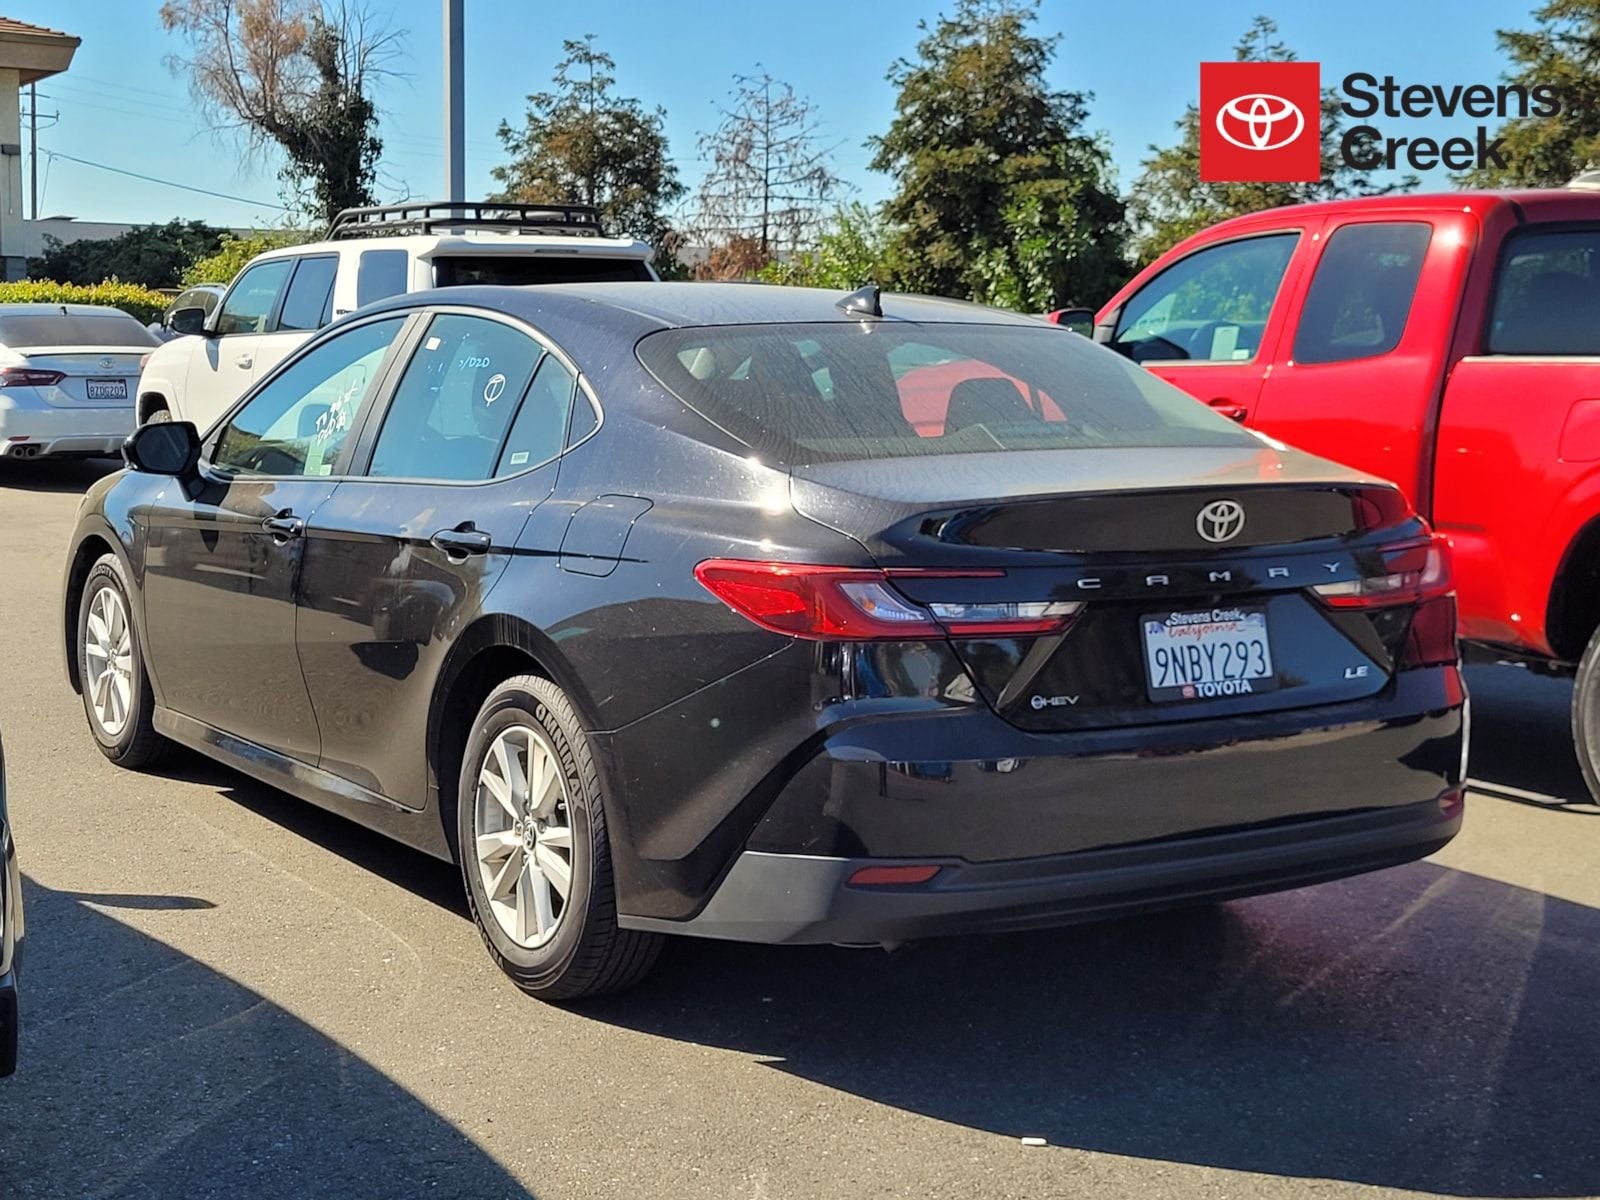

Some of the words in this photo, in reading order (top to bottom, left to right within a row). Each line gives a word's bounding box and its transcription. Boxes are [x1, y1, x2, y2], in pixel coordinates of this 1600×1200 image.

[1077, 561, 1340, 589] CAMRY
[1170, 611, 1211, 626] Stevens
[1212, 608, 1241, 622] Creek
[1155, 639, 1266, 686] 9NBY293
[1344, 665, 1368, 679] LE
[1195, 679, 1252, 698] TOYOTA
[535, 703, 586, 813] OMNIMAX
